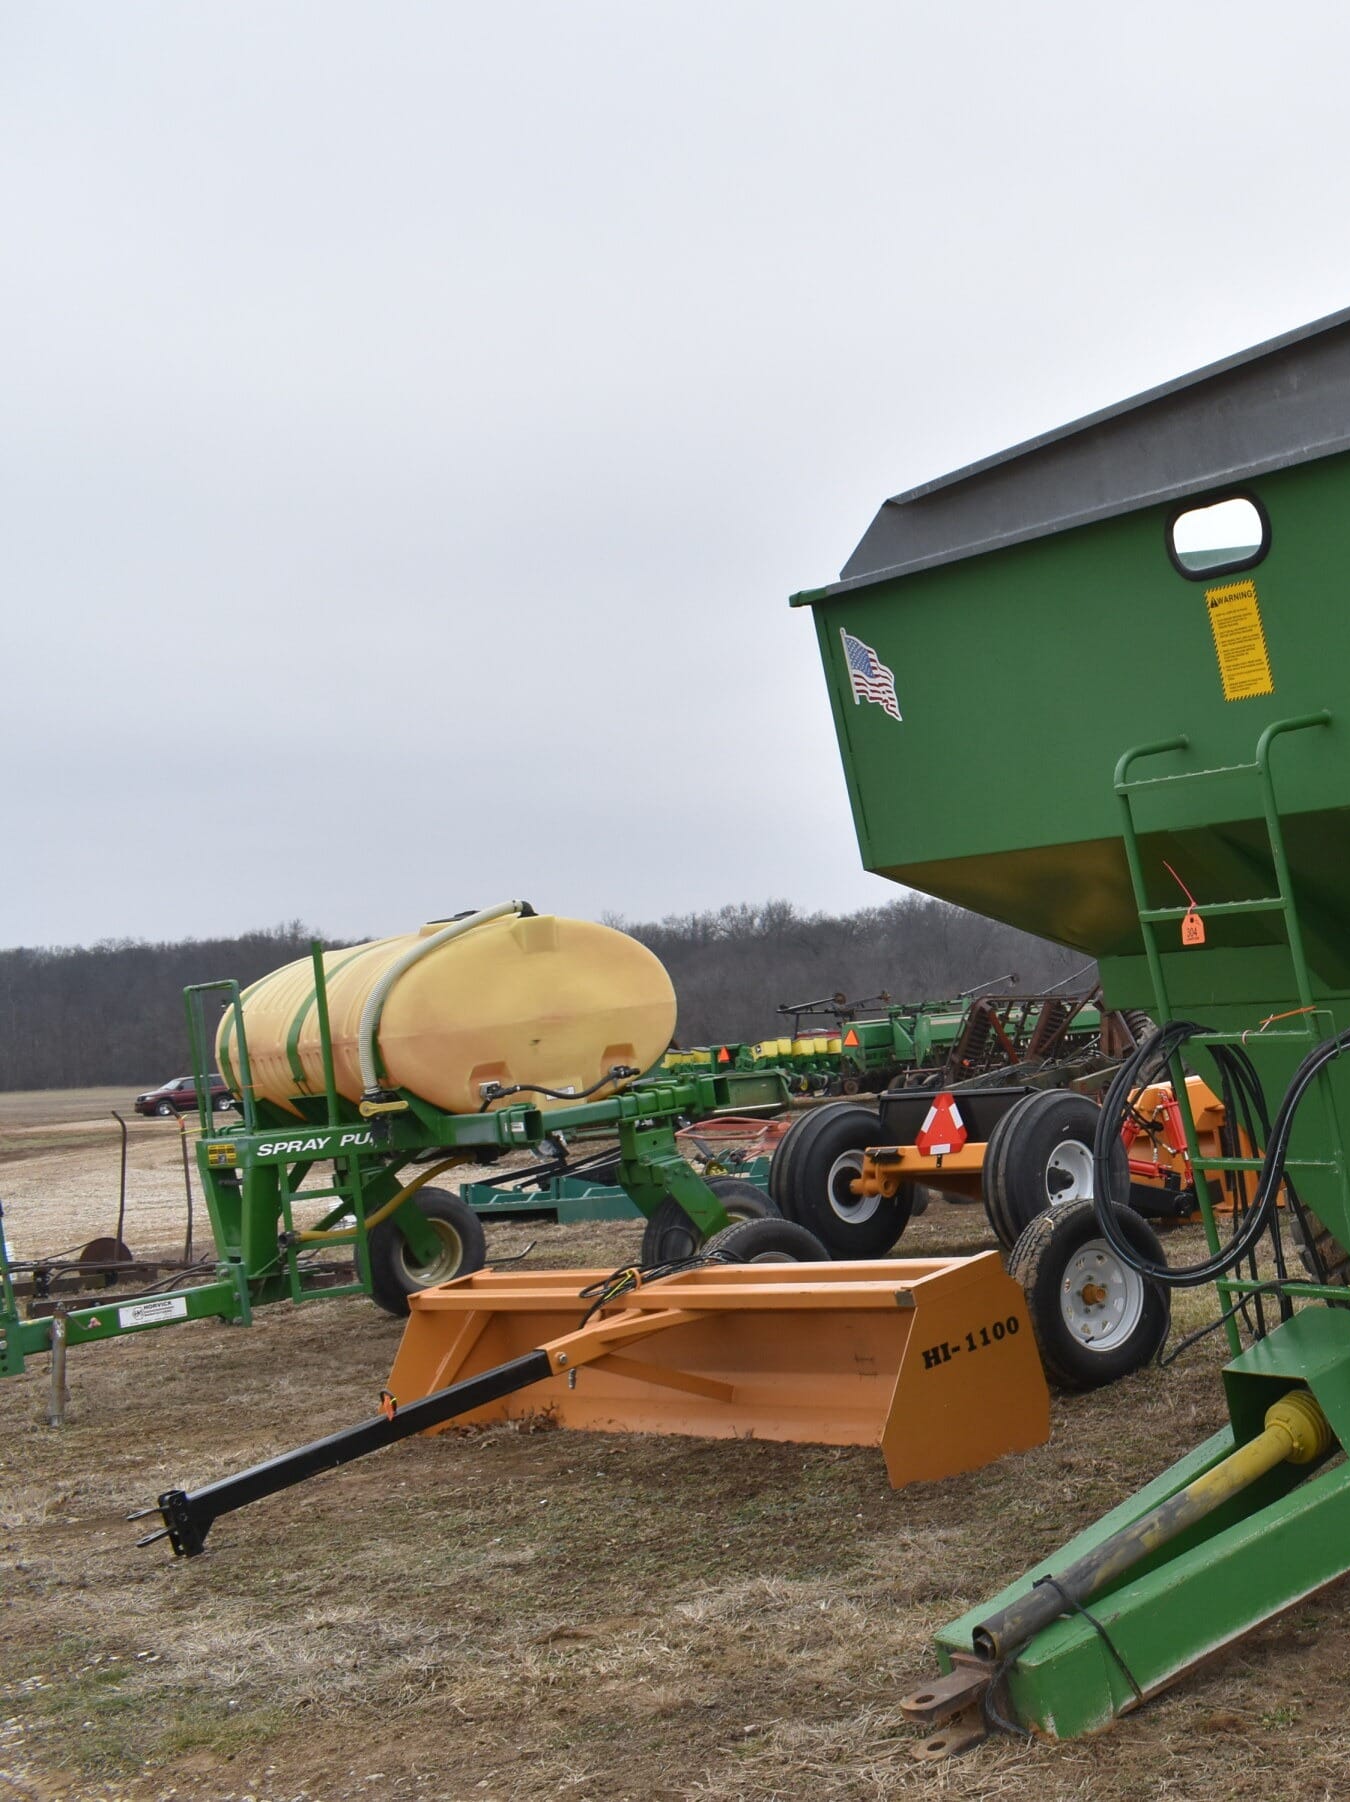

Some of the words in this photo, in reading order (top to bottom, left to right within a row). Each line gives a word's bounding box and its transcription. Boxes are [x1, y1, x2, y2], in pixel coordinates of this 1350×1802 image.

[1216, 589, 1253, 605] WARNING
[256, 1136, 332, 1157] SPRAY
[339, 1131, 374, 1147] PU
[922, 1315, 1019, 1370] HI-1100
